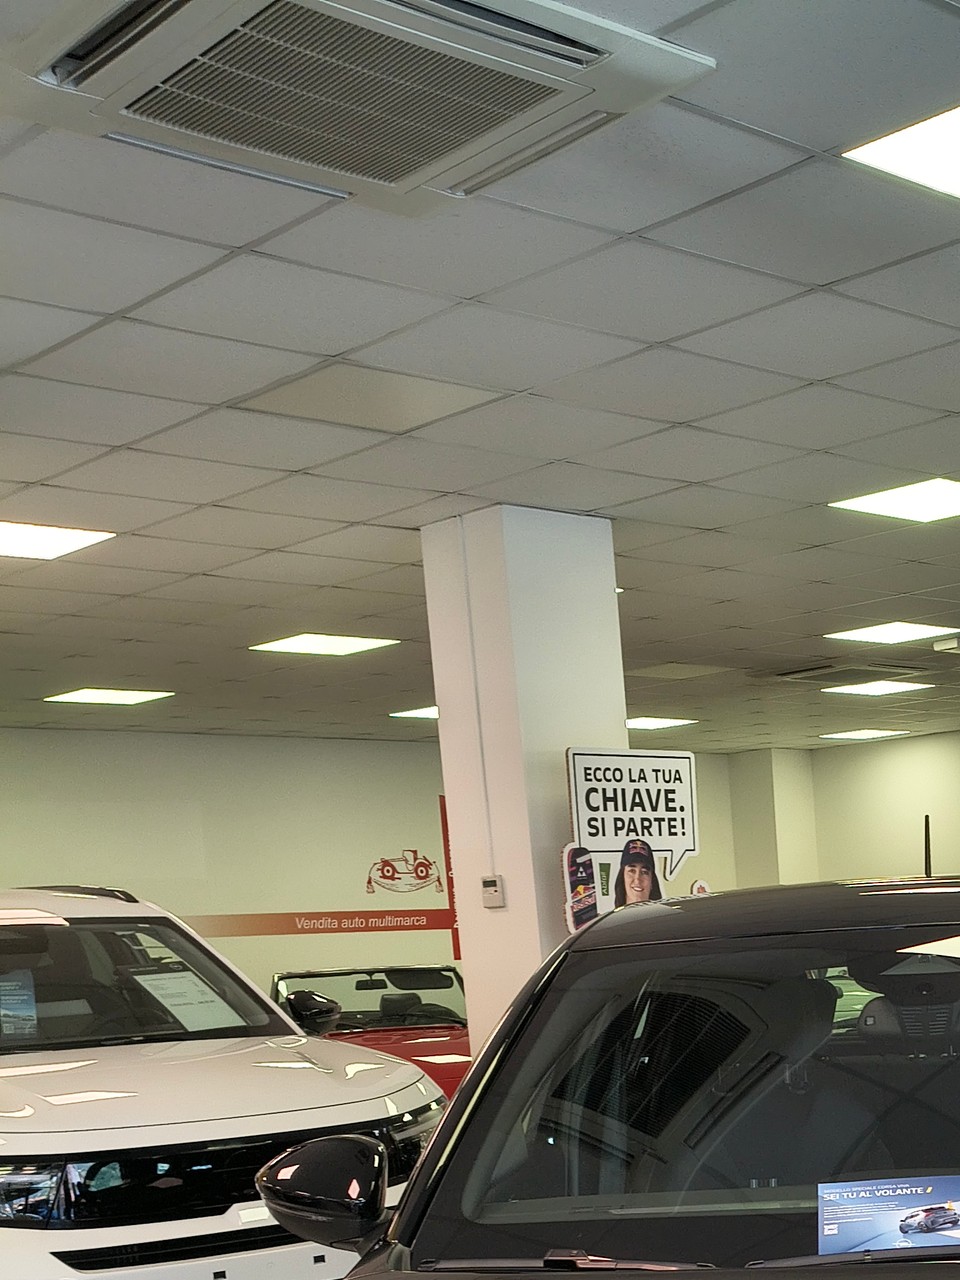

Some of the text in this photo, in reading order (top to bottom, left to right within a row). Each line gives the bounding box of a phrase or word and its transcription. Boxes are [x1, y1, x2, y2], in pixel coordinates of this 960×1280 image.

[583, 766, 683, 784] ECCO LA TUA
[584, 786, 685, 813] CHIAVE.
[587, 816, 686, 838] SI PARTE!
[295, 915, 427, 929] Vendita auto multimarca
[823, 1187, 924, 1201] SEI TU AL VOLANTE
